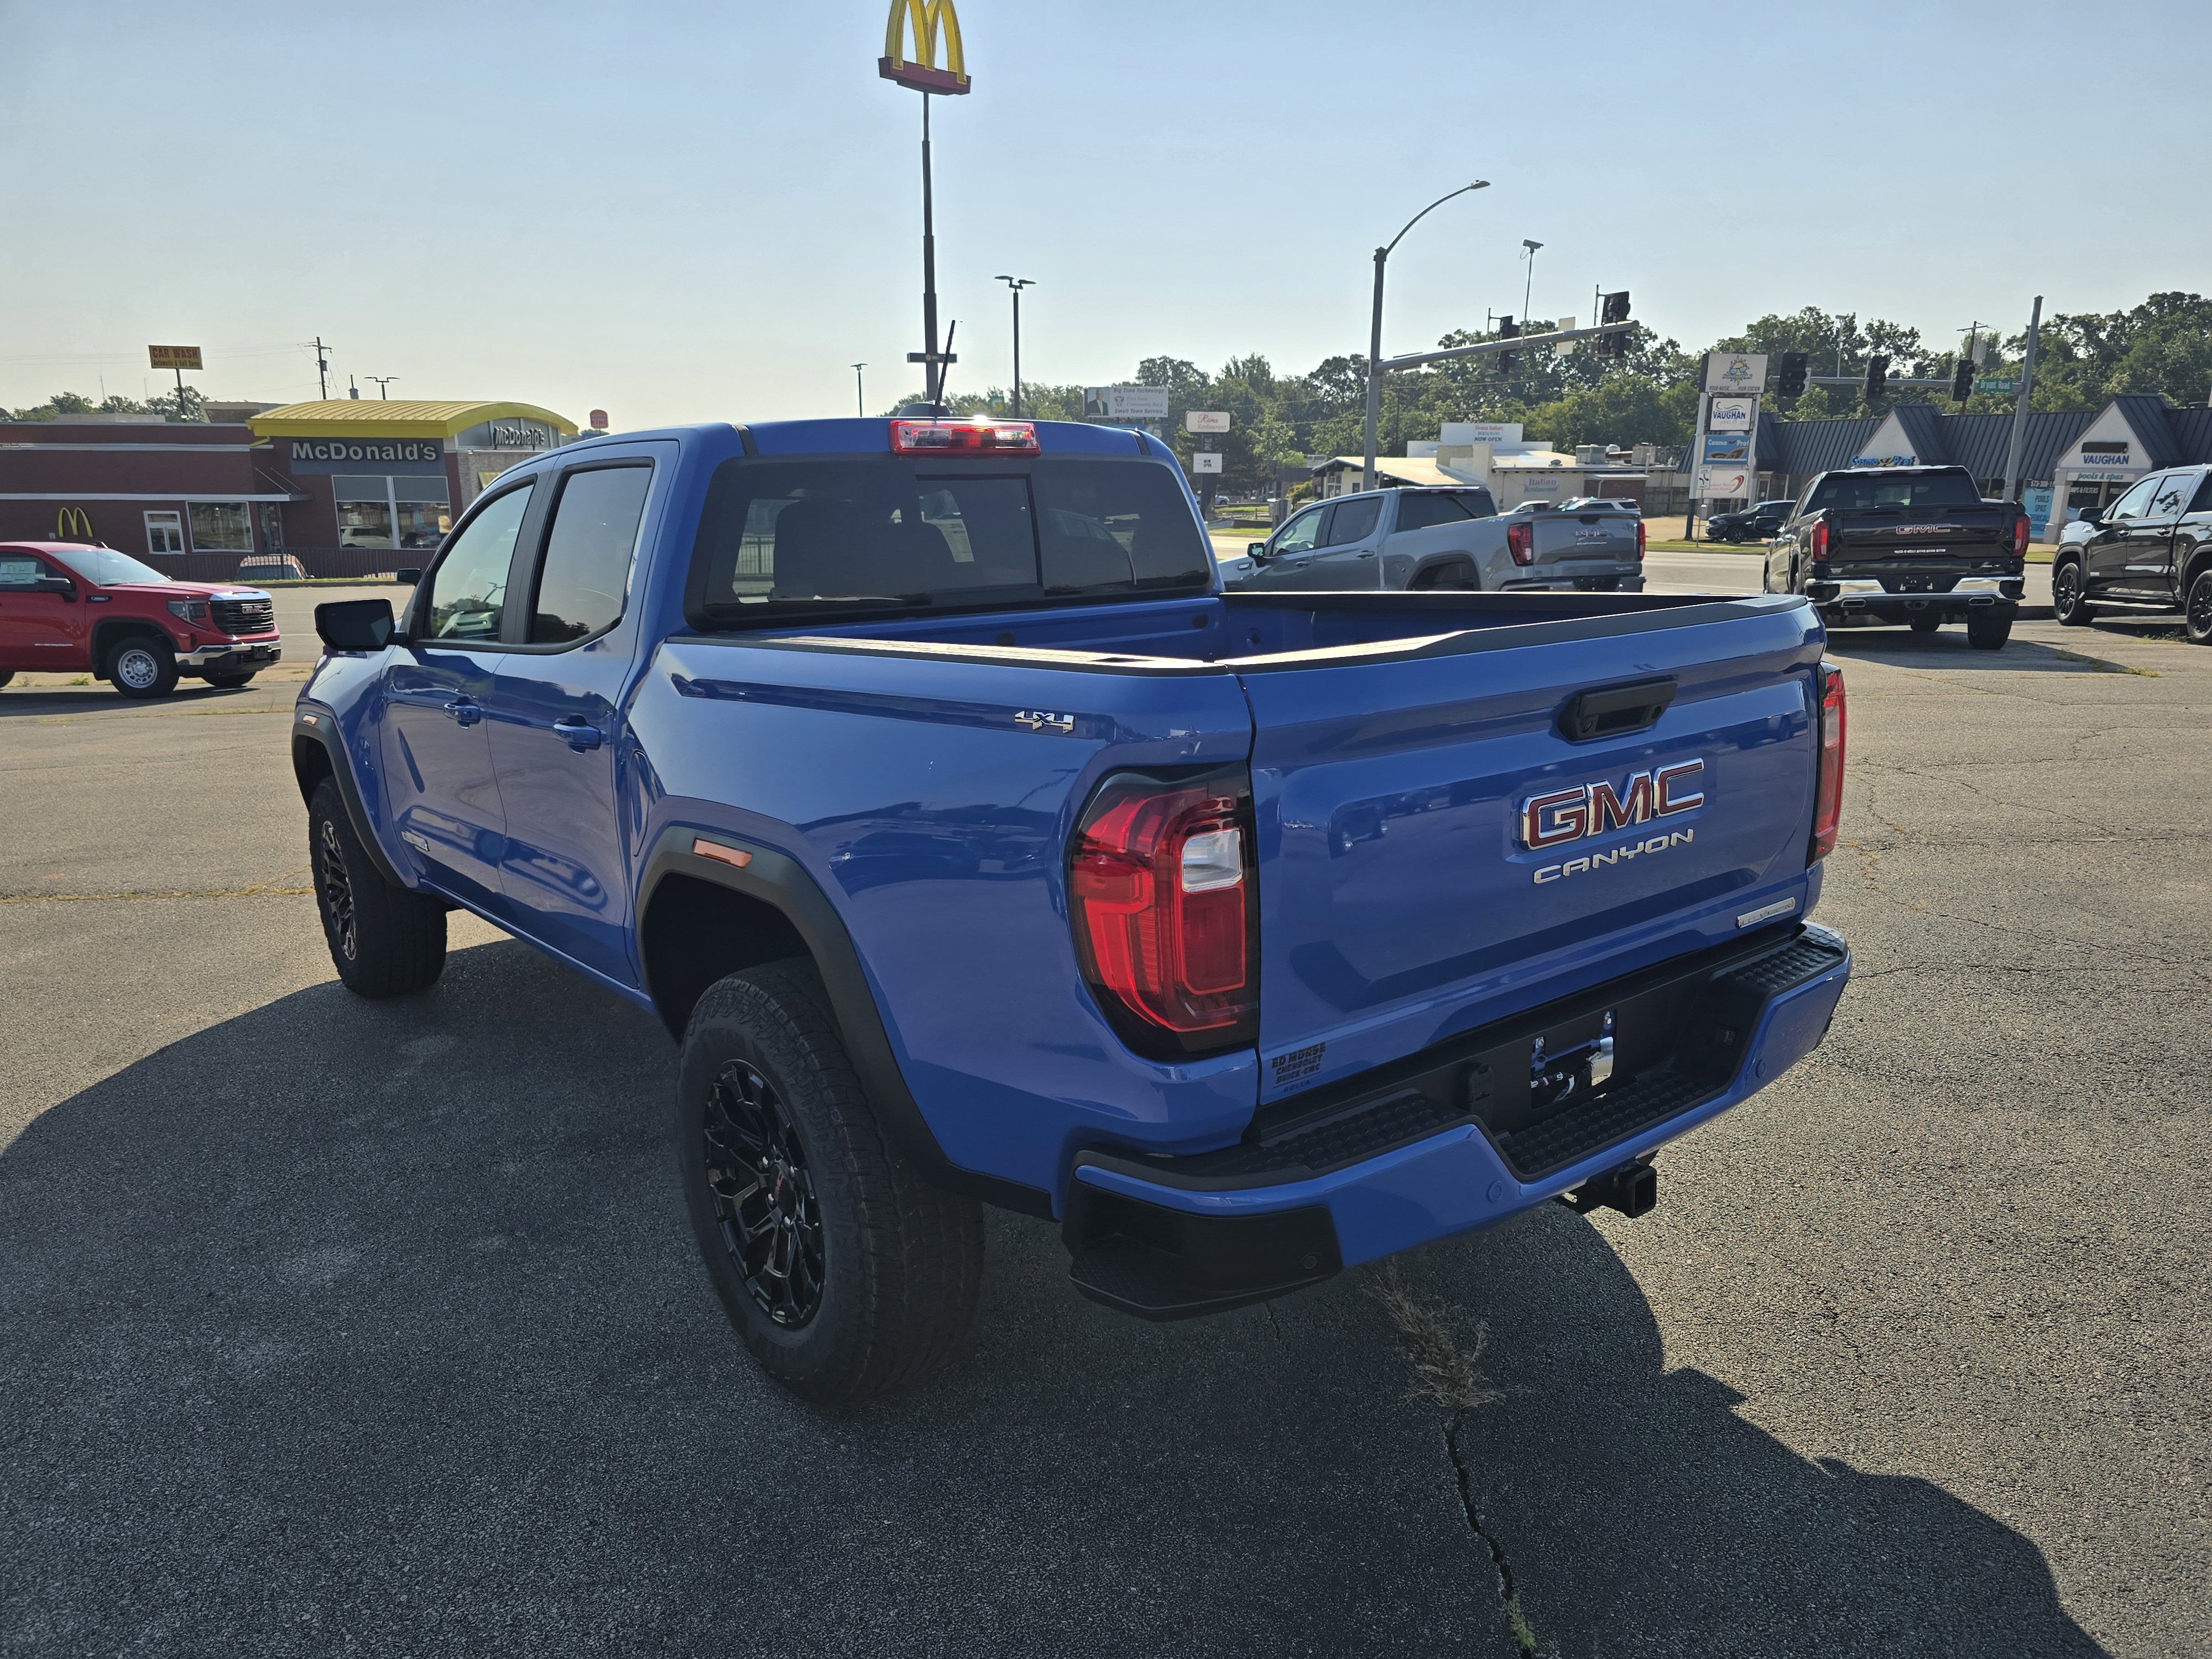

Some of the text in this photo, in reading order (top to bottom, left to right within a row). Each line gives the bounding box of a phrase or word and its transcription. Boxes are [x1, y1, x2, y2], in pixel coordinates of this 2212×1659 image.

[152, 347, 198, 359] CAR WASH
[1980, 379, 2010, 390] Bryant Road
[1713, 411, 1746, 419] VAUGHAN
[494, 426, 545, 446] McDonald's
[291, 441, 437, 462] McDonald's
[1850, 455, 1916, 466] Cosmo Prof
[2083, 455, 2130, 465] VAUGHAN
[2077, 472, 2099, 482] pools
[2106, 473, 2124, 482] spas
[2035, 495, 2050, 503] POOLS
[1896, 523, 1951, 535] GMC
[1521, 758, 1704, 851] GMC
[1533, 828, 1694, 884] CANYON
